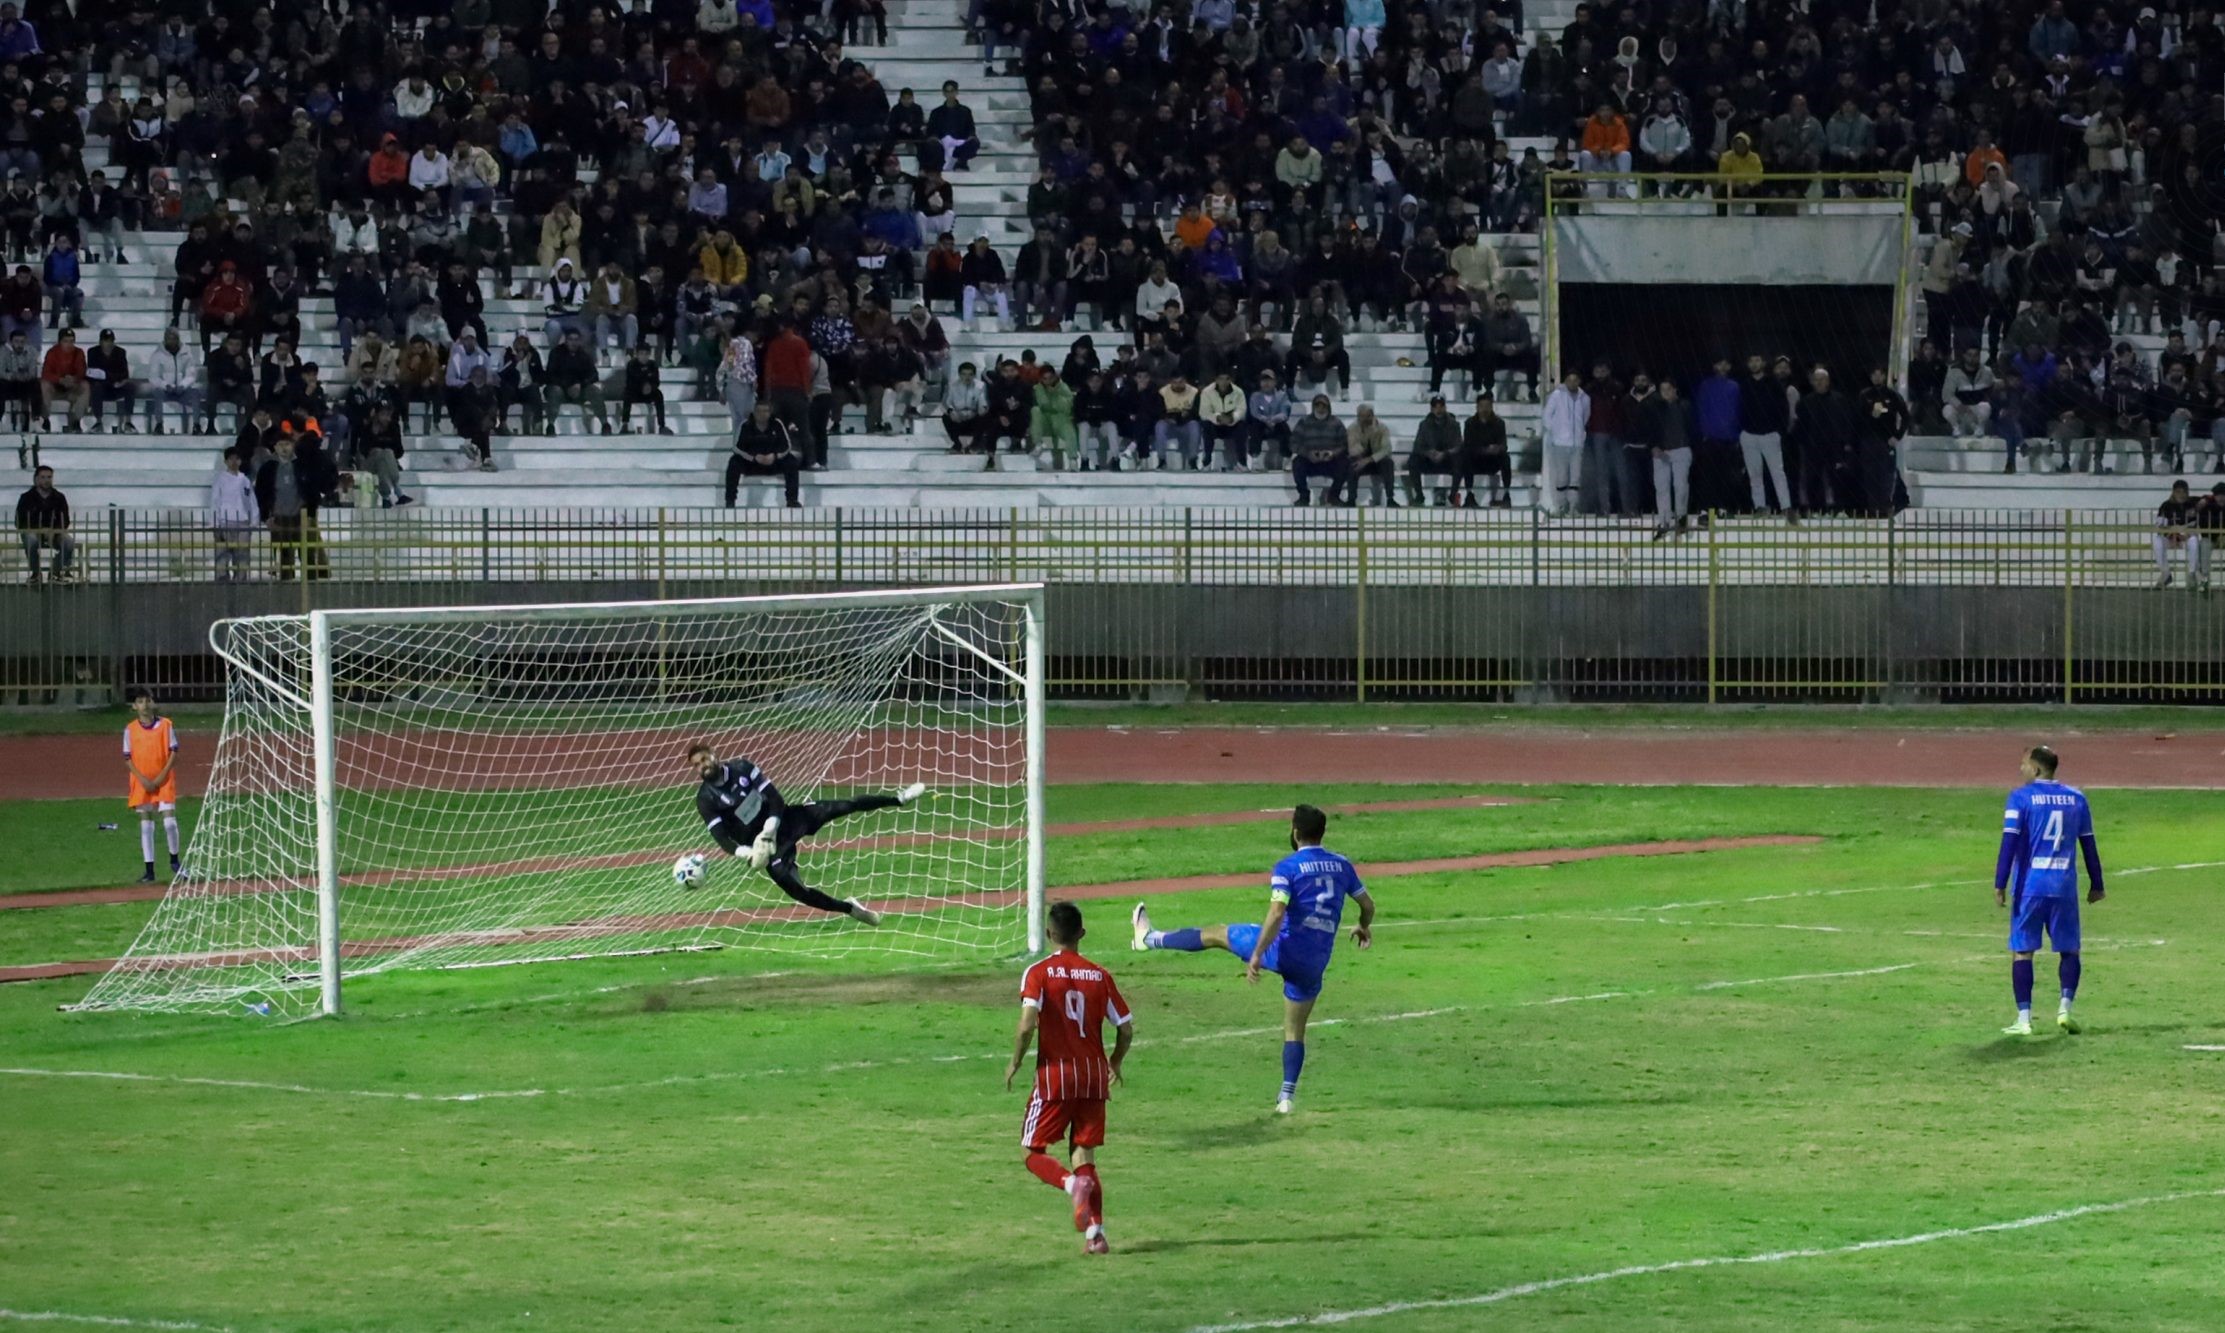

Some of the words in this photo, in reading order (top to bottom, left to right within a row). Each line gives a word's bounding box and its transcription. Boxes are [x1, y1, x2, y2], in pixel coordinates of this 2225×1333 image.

[2031, 794, 2076, 806] HUTTEEN
[2042, 809, 2065, 852] 4
[1298, 861, 1343, 873] HUTTEEN
[1314, 874, 1335, 916] 2
[1070, 968, 1103, 981] AHMAD
[1065, 989, 1086, 1038] 9
